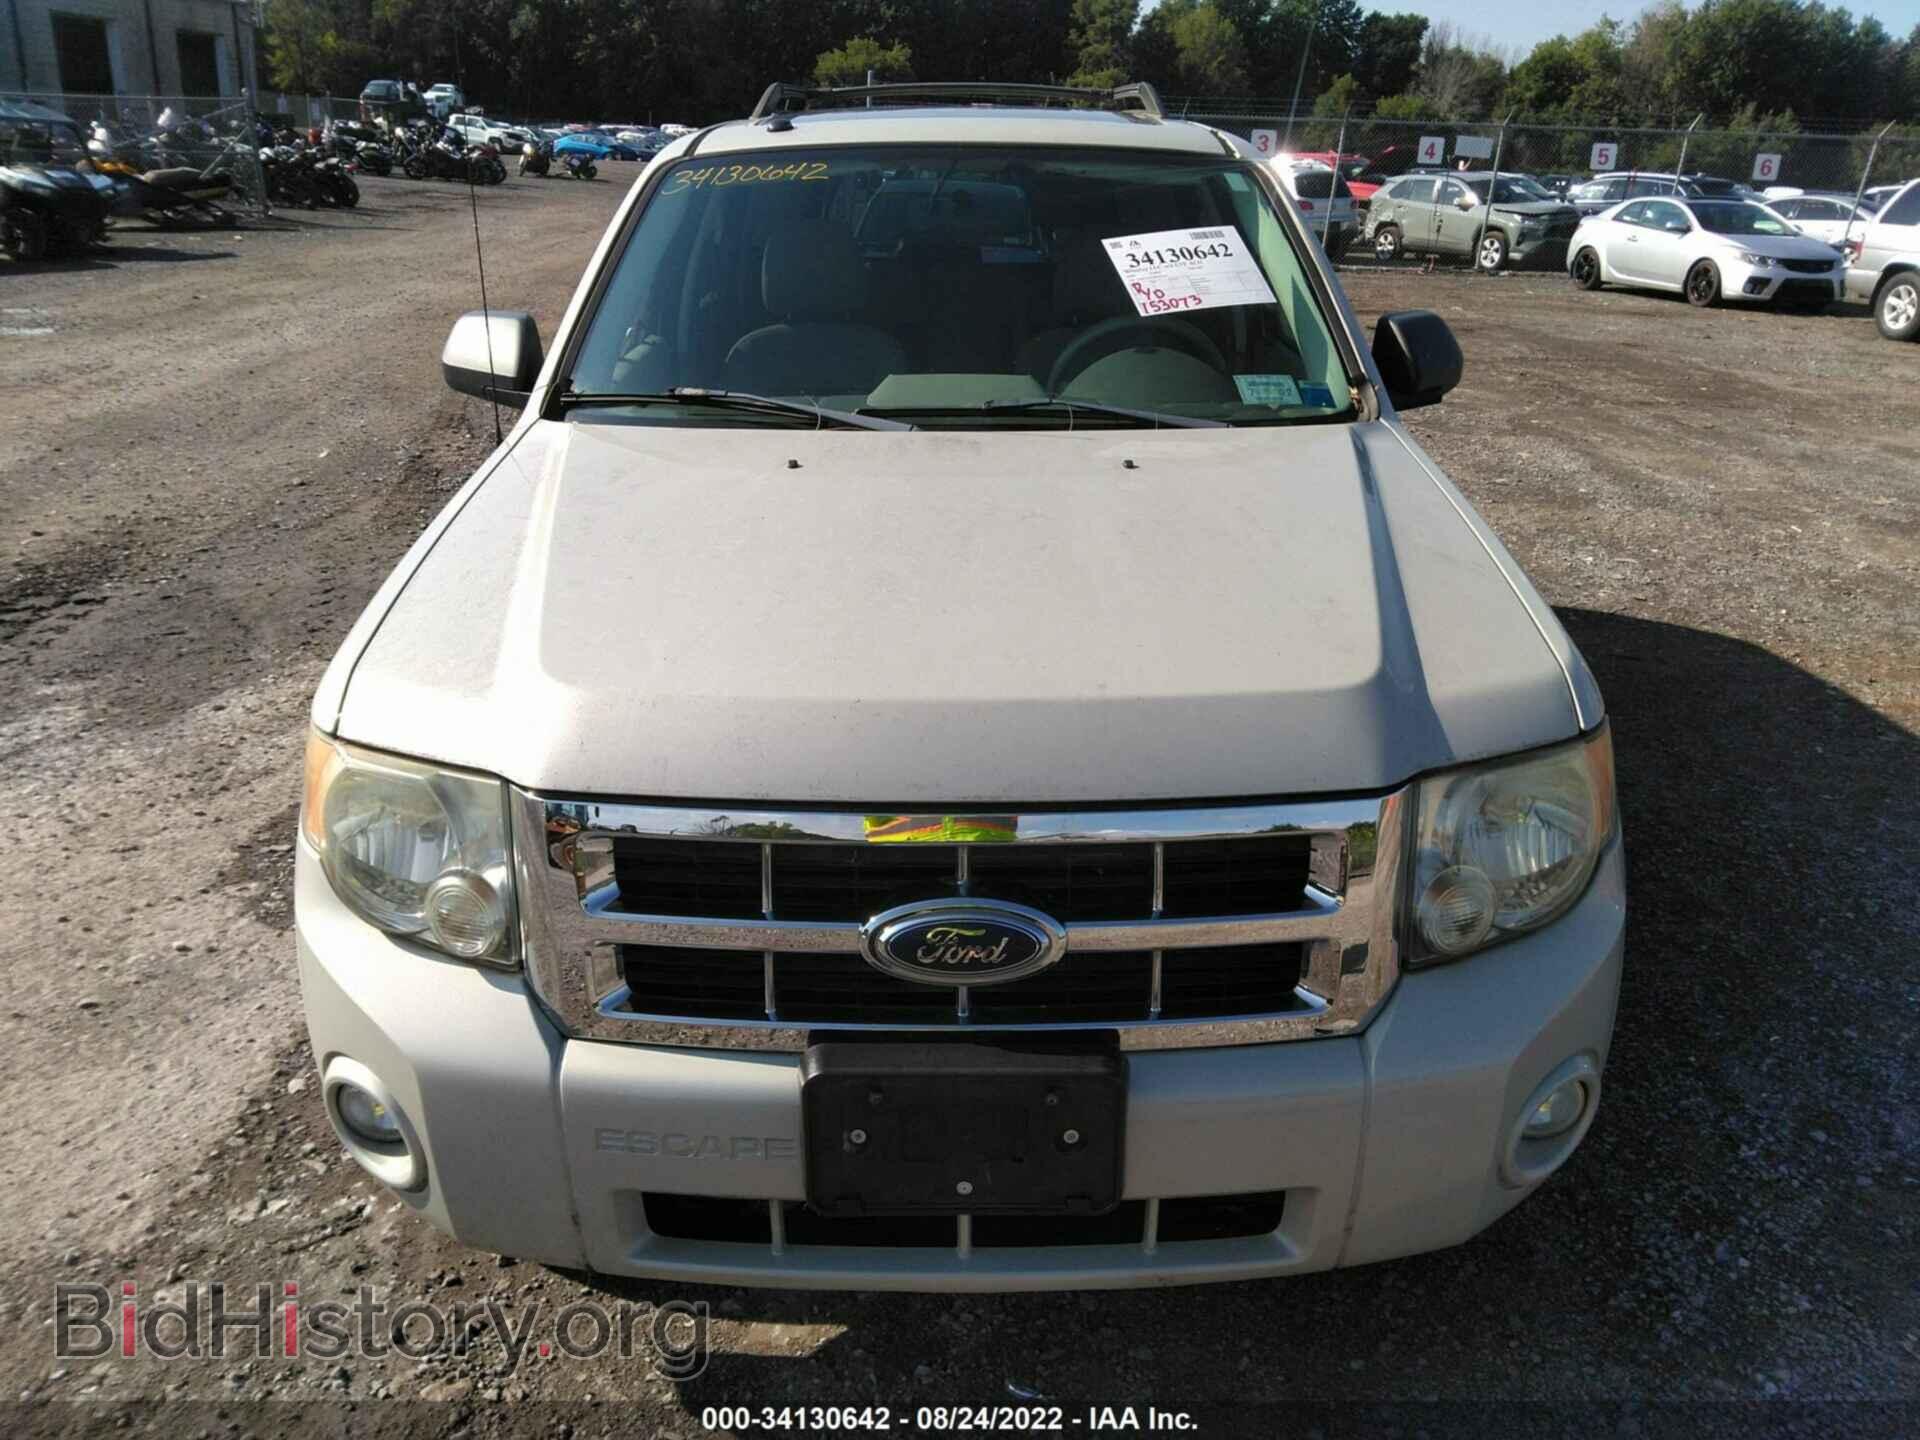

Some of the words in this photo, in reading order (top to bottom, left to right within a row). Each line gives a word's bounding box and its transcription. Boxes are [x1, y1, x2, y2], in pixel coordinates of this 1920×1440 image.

[1258, 135, 1269, 151] 3
[1425, 142, 1436, 159] 4
[1598, 150, 1609, 166] 5
[1760, 160, 1772, 176] 6
[1126, 243, 1233, 268] 34130642
[1142, 295, 1203, 314] 153073
[916, 926, 1009, 964] Ford
[595, 1128, 797, 1160] ESCAPE
